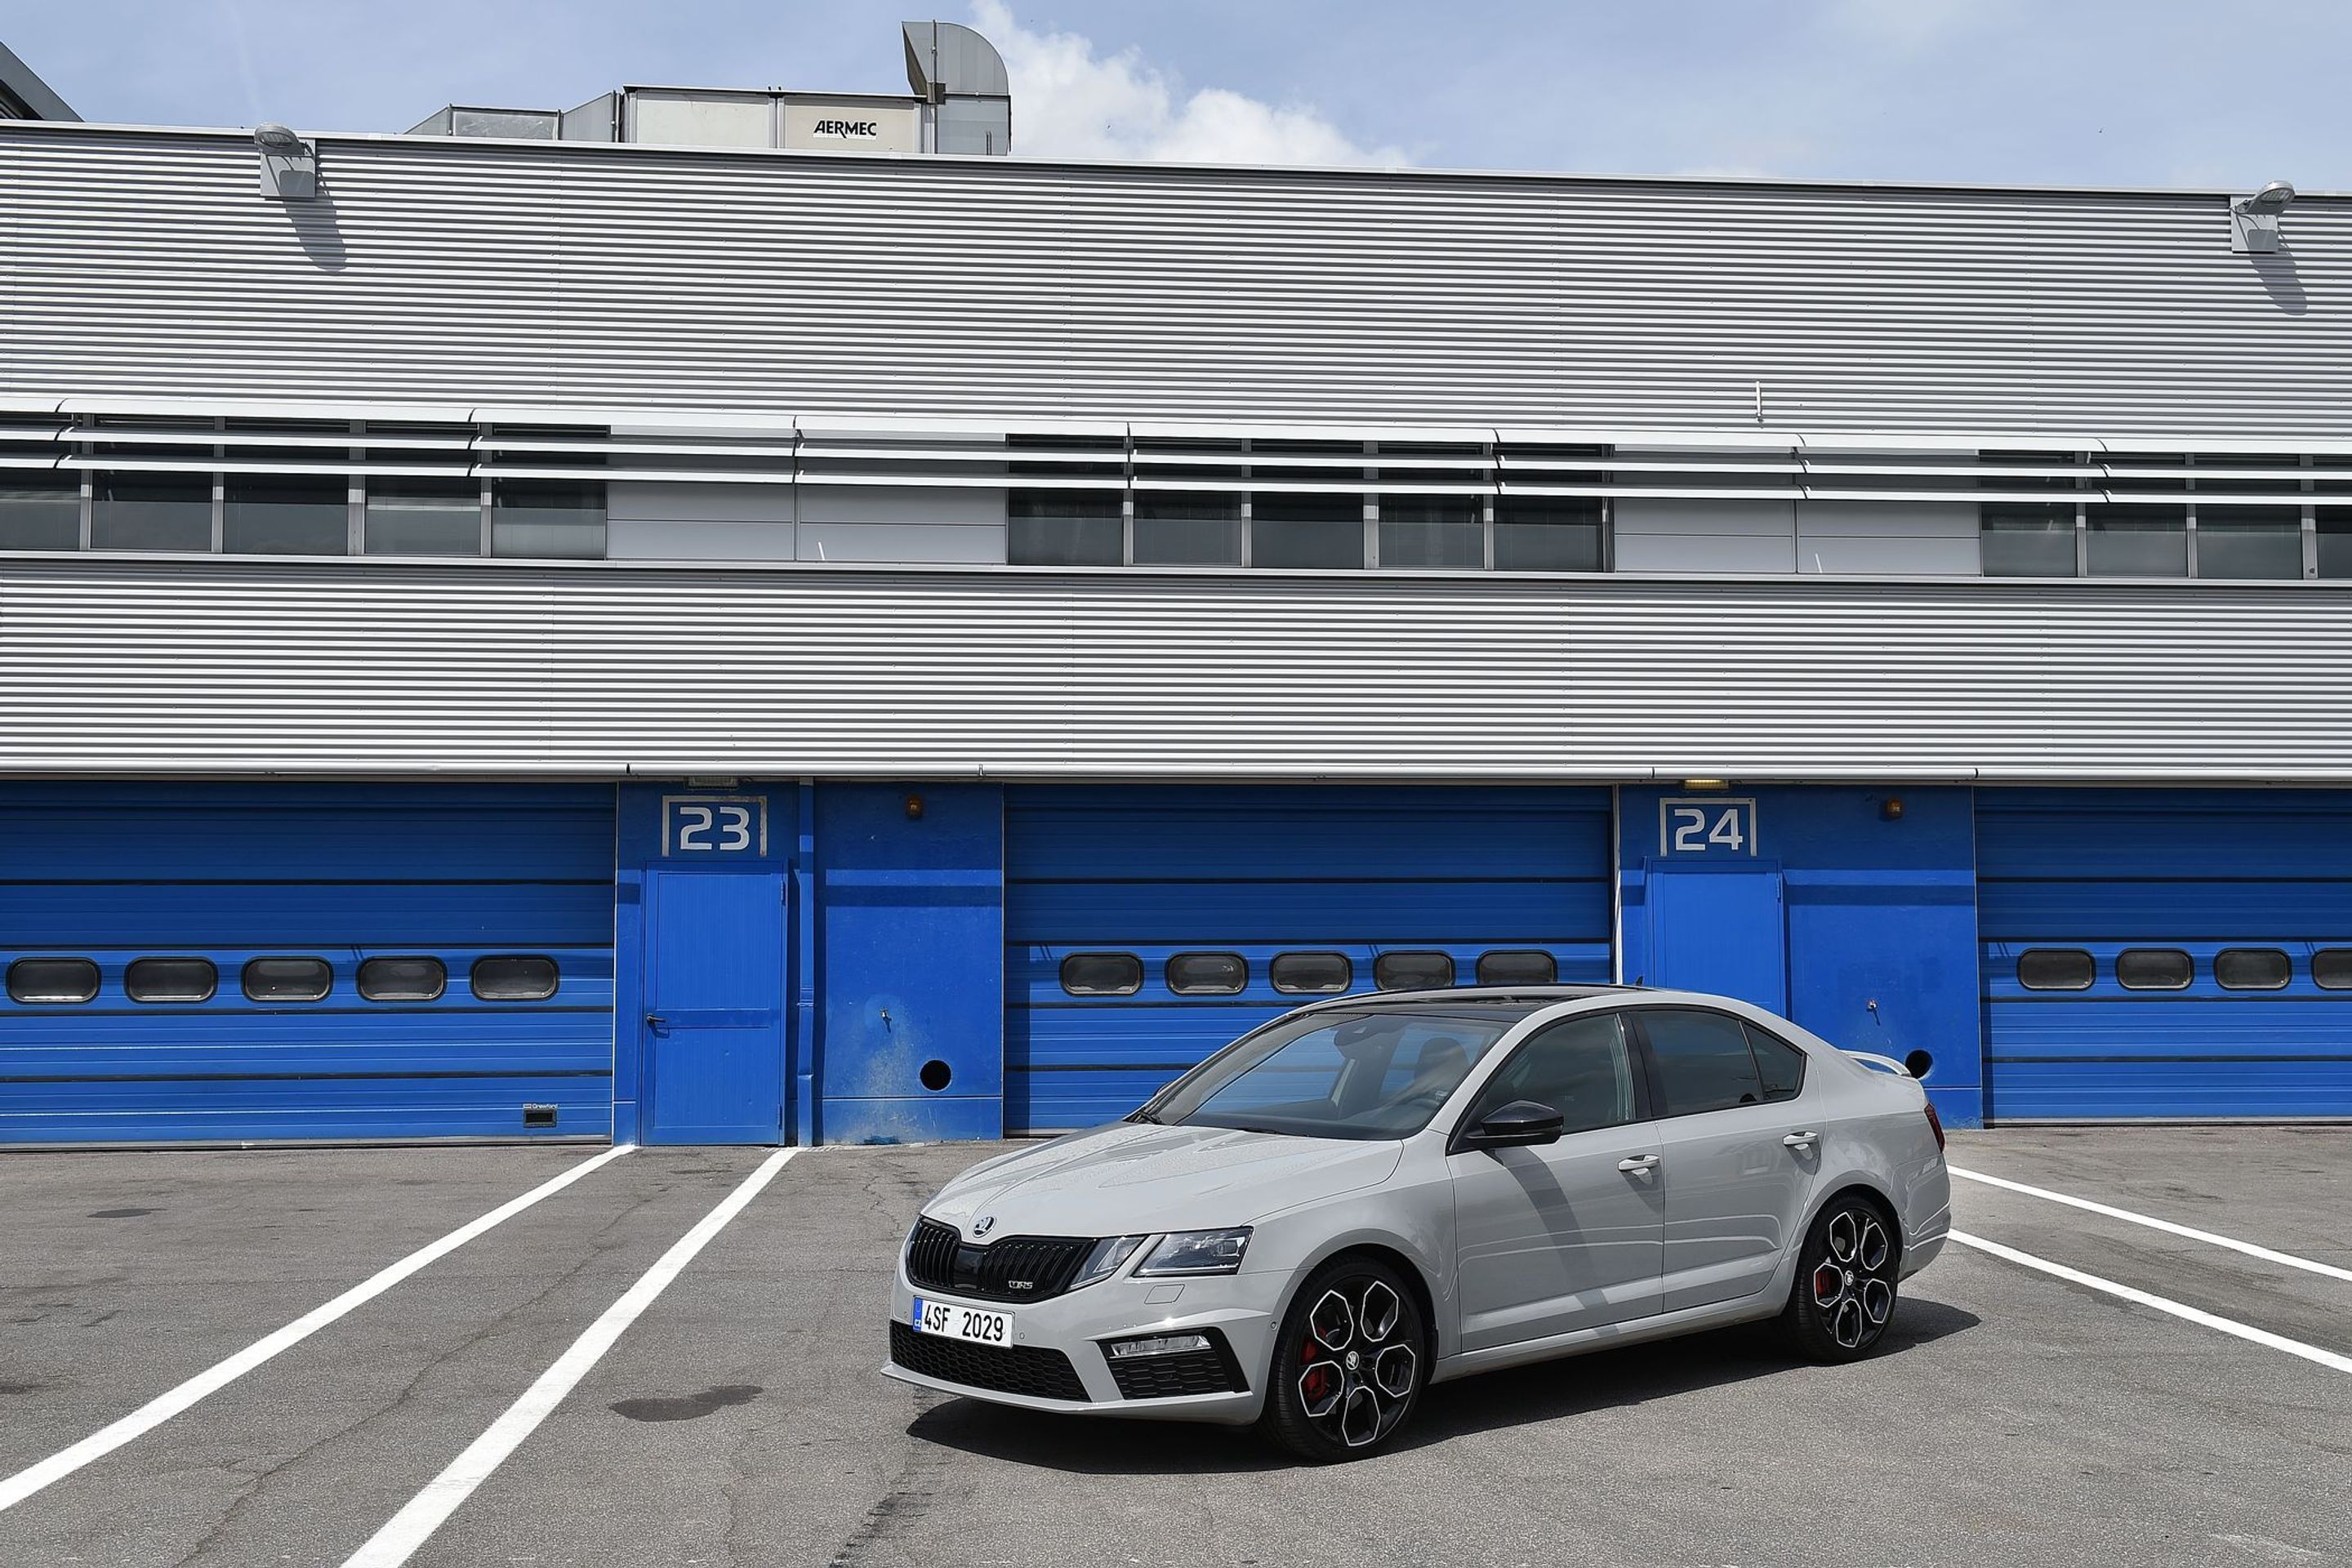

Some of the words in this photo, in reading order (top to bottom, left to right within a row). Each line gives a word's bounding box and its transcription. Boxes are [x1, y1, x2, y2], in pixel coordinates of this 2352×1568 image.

[813, 120, 877, 139] AERMEC
[679, 806, 750, 850] 23
[1674, 808, 1743, 850] 24
[924, 1304, 951, 1333] 4SF
[962, 1312, 1004, 1342] 2029
